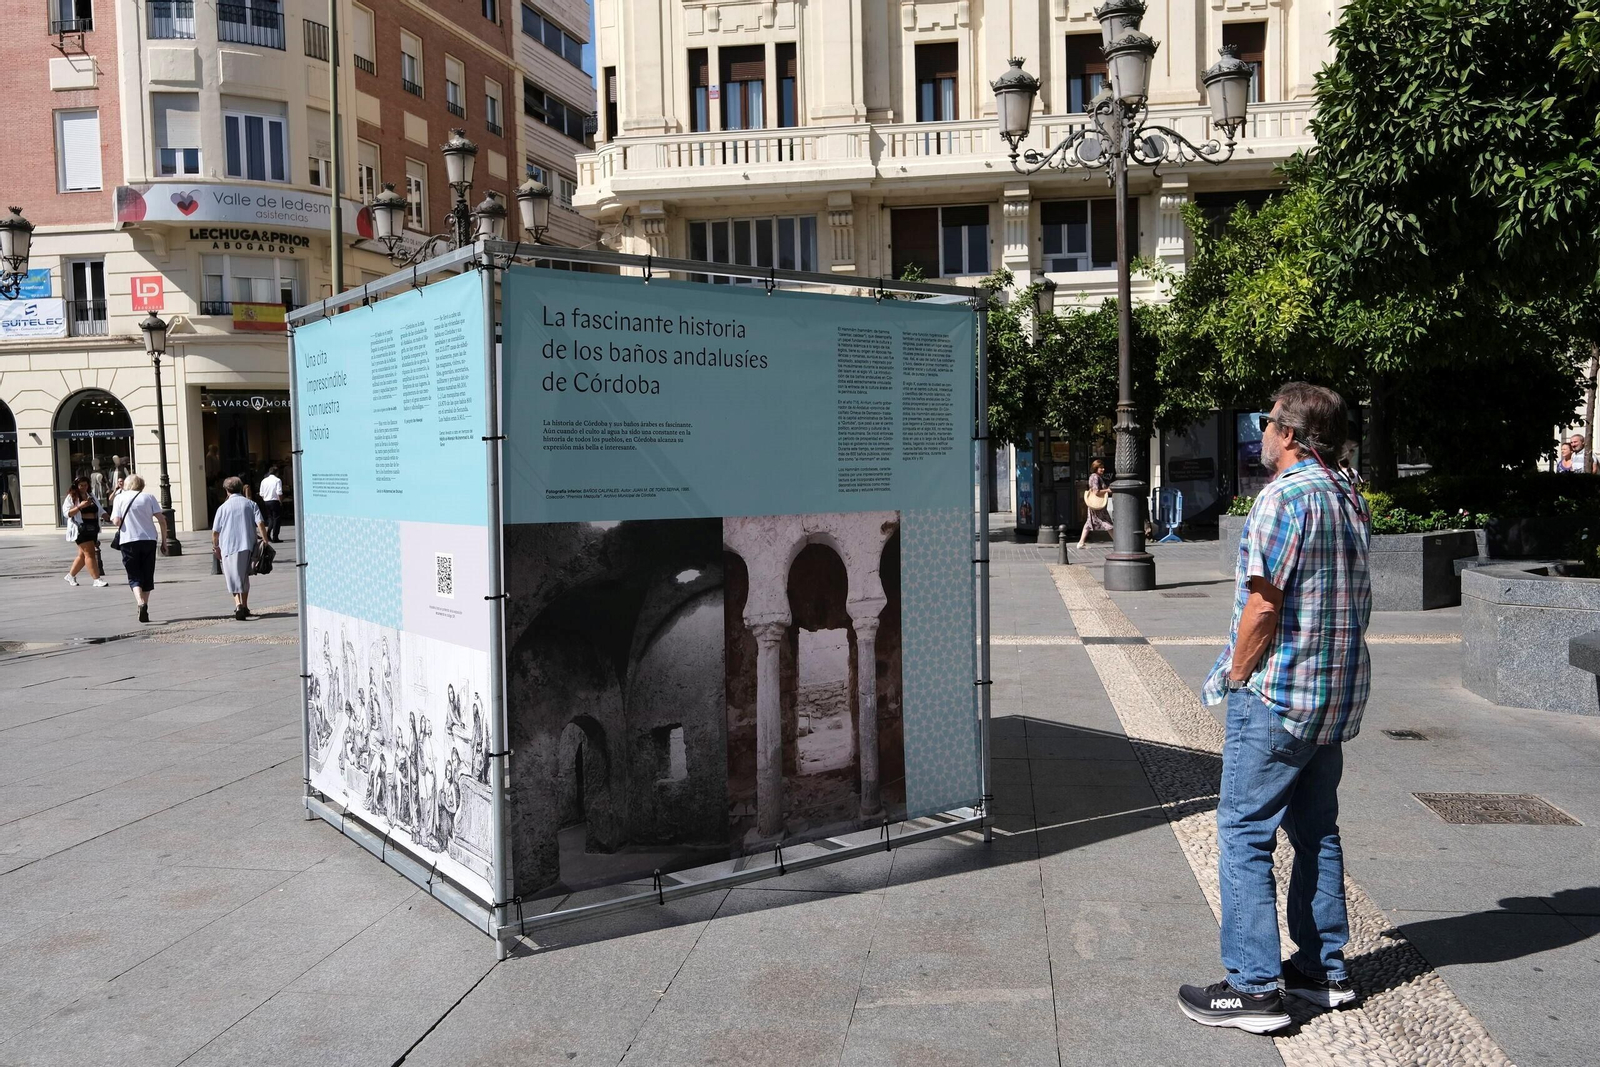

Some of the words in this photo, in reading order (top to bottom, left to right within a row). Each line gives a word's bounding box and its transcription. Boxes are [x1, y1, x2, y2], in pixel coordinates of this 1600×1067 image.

[213, 192, 250, 206] Valle
[256, 195, 276, 208] de
[281, 196, 330, 214] ledesm
[256, 209, 309, 222] asistencias
[190, 228, 310, 248] LECHUGA&PRIOR
[212, 242, 295, 254] ABOGADOS
[2, 318, 63, 328] SUITELEC
[543, 305, 565, 327] La
[571, 308, 674, 334] fascinante
[679, 316, 746, 338] historia
[305, 352, 316, 368] Una
[317, 350, 328, 366] cita
[542, 339, 567, 360] de
[574, 340, 603, 361] los
[610, 342, 667, 364] baños
[673, 348, 768, 369] andalusíes
[306, 370, 347, 394] imprescindible
[542, 371, 567, 392] de
[574, 372, 660, 395] Córdoba
[308, 404, 318, 416] con
[318, 400, 340, 415] nuestra
[309, 424, 330, 440] historia
[1210, 998, 1243, 1009] HOKA
